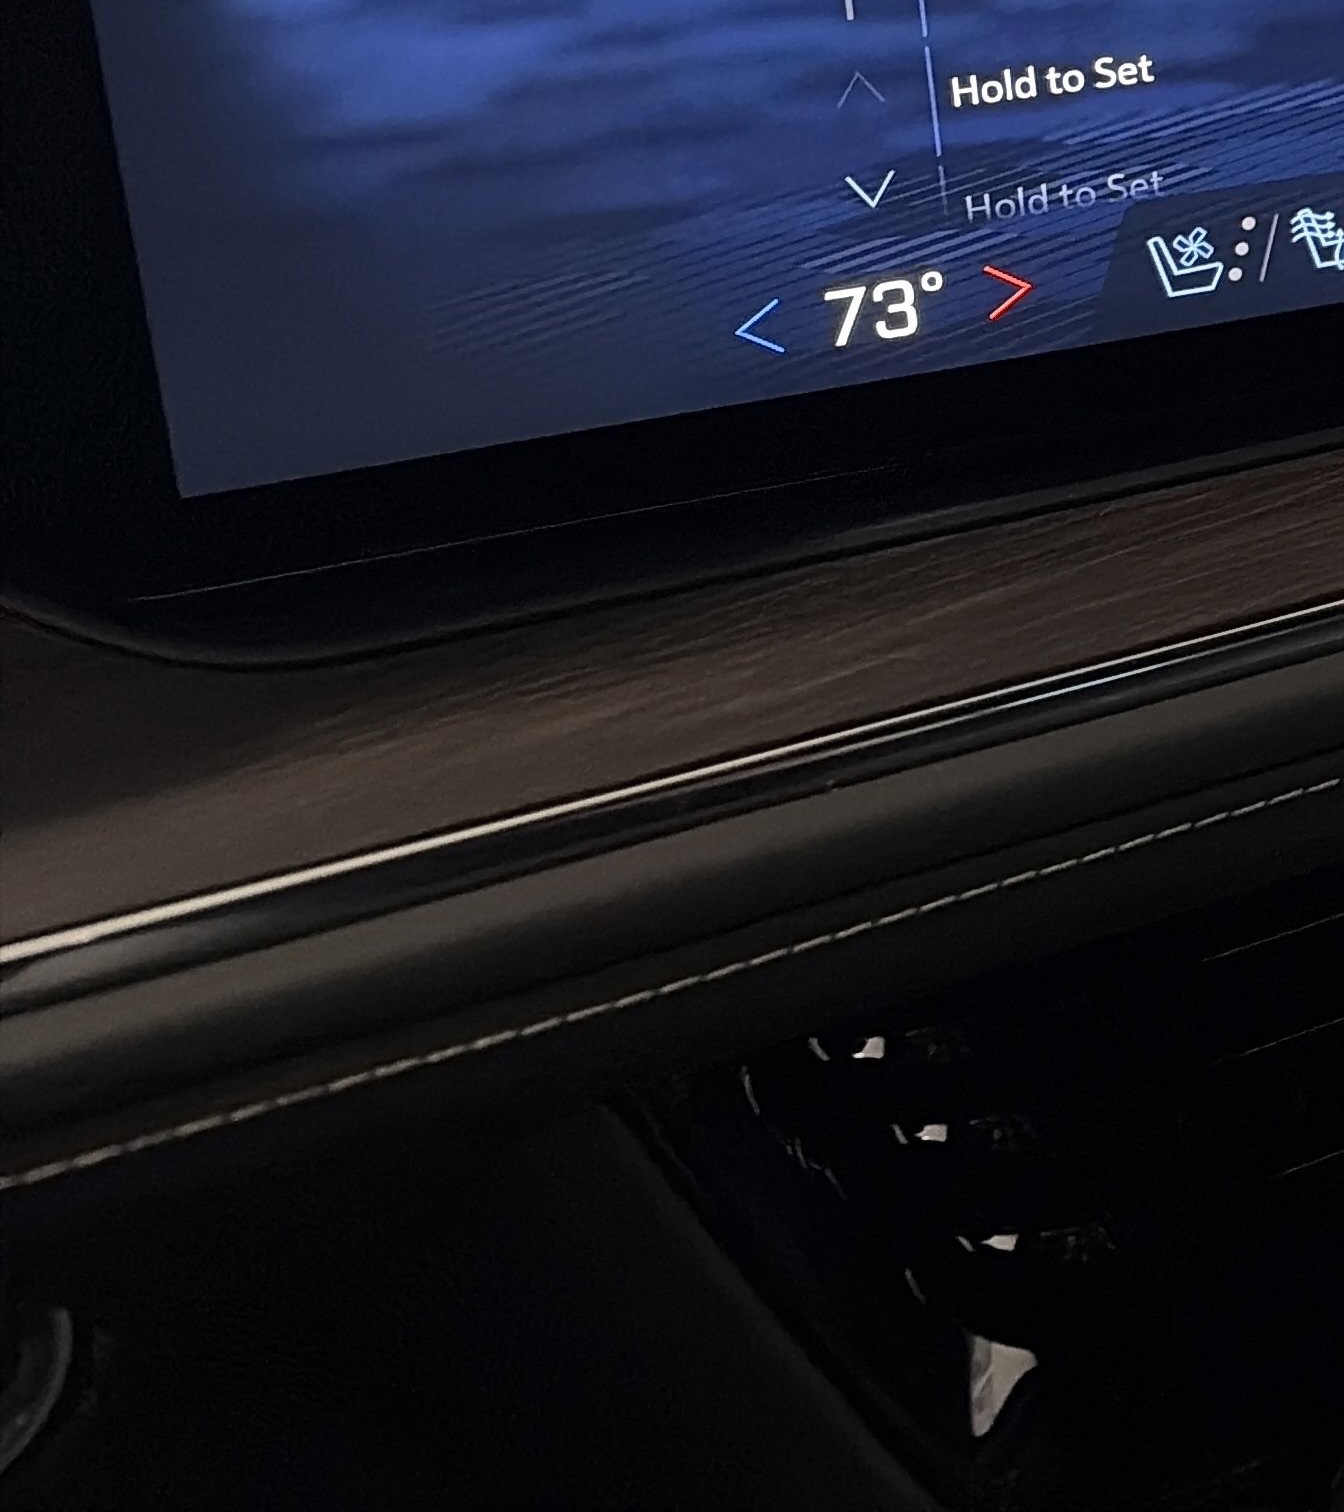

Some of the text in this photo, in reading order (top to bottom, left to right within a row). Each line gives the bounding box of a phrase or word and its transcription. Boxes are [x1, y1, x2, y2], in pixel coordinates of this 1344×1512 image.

[950, 54, 1155, 107] Hold to Set
[964, 170, 1164, 222] Hold to Set
[824, 270, 944, 348] 73°
